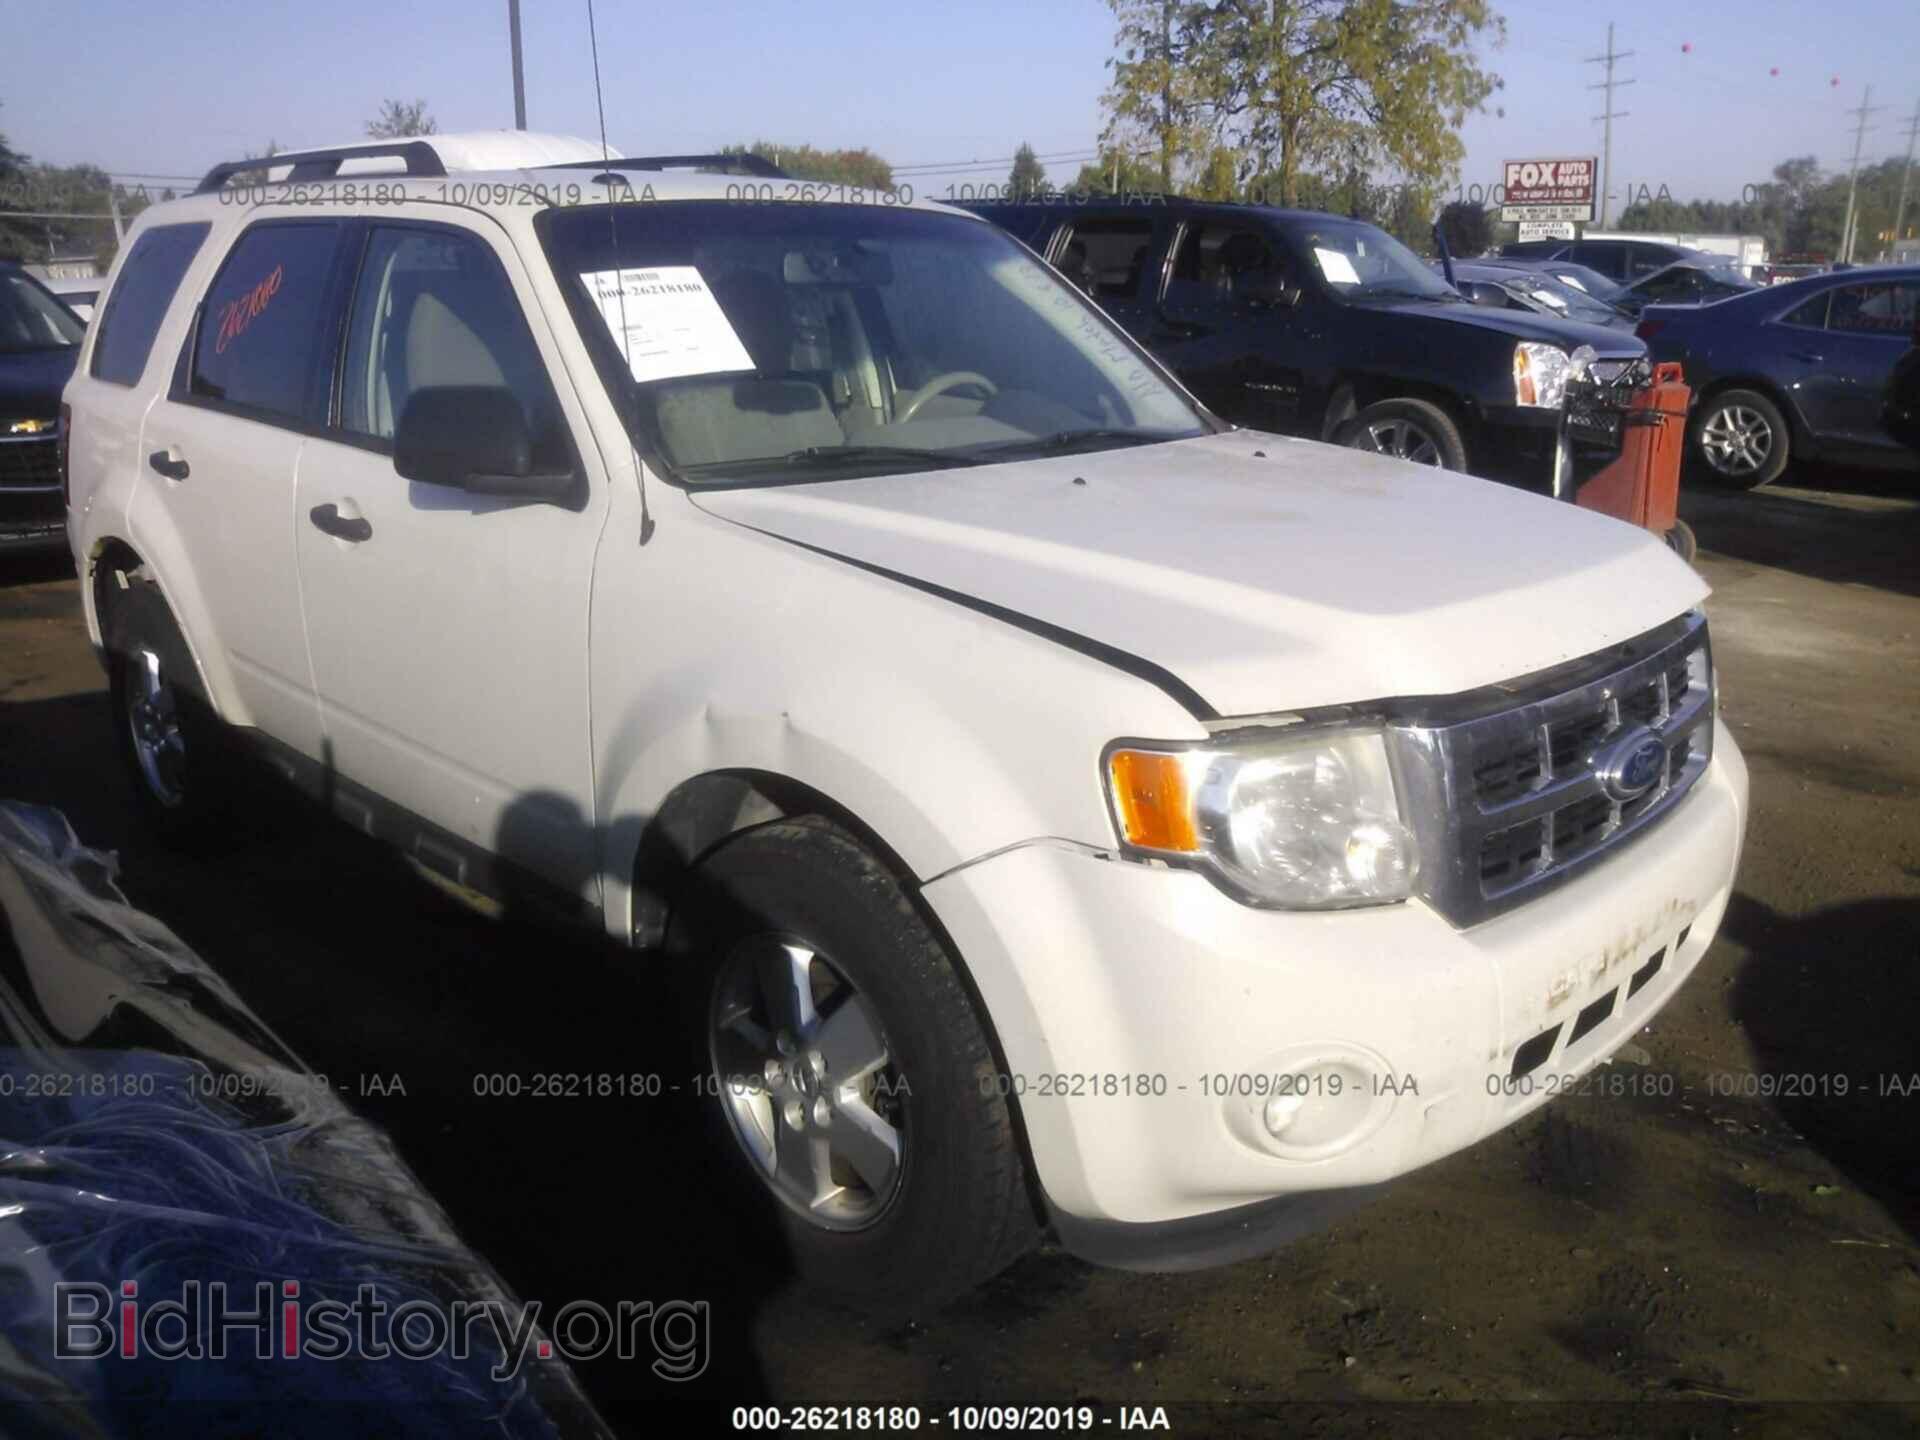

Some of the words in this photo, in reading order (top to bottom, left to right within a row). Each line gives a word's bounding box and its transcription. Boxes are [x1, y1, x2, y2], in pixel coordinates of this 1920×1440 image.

[1558, 163, 1587, 175] AUTO
[1507, 164, 1556, 188] FOX
[1557, 175, 1589, 187] PARTS
